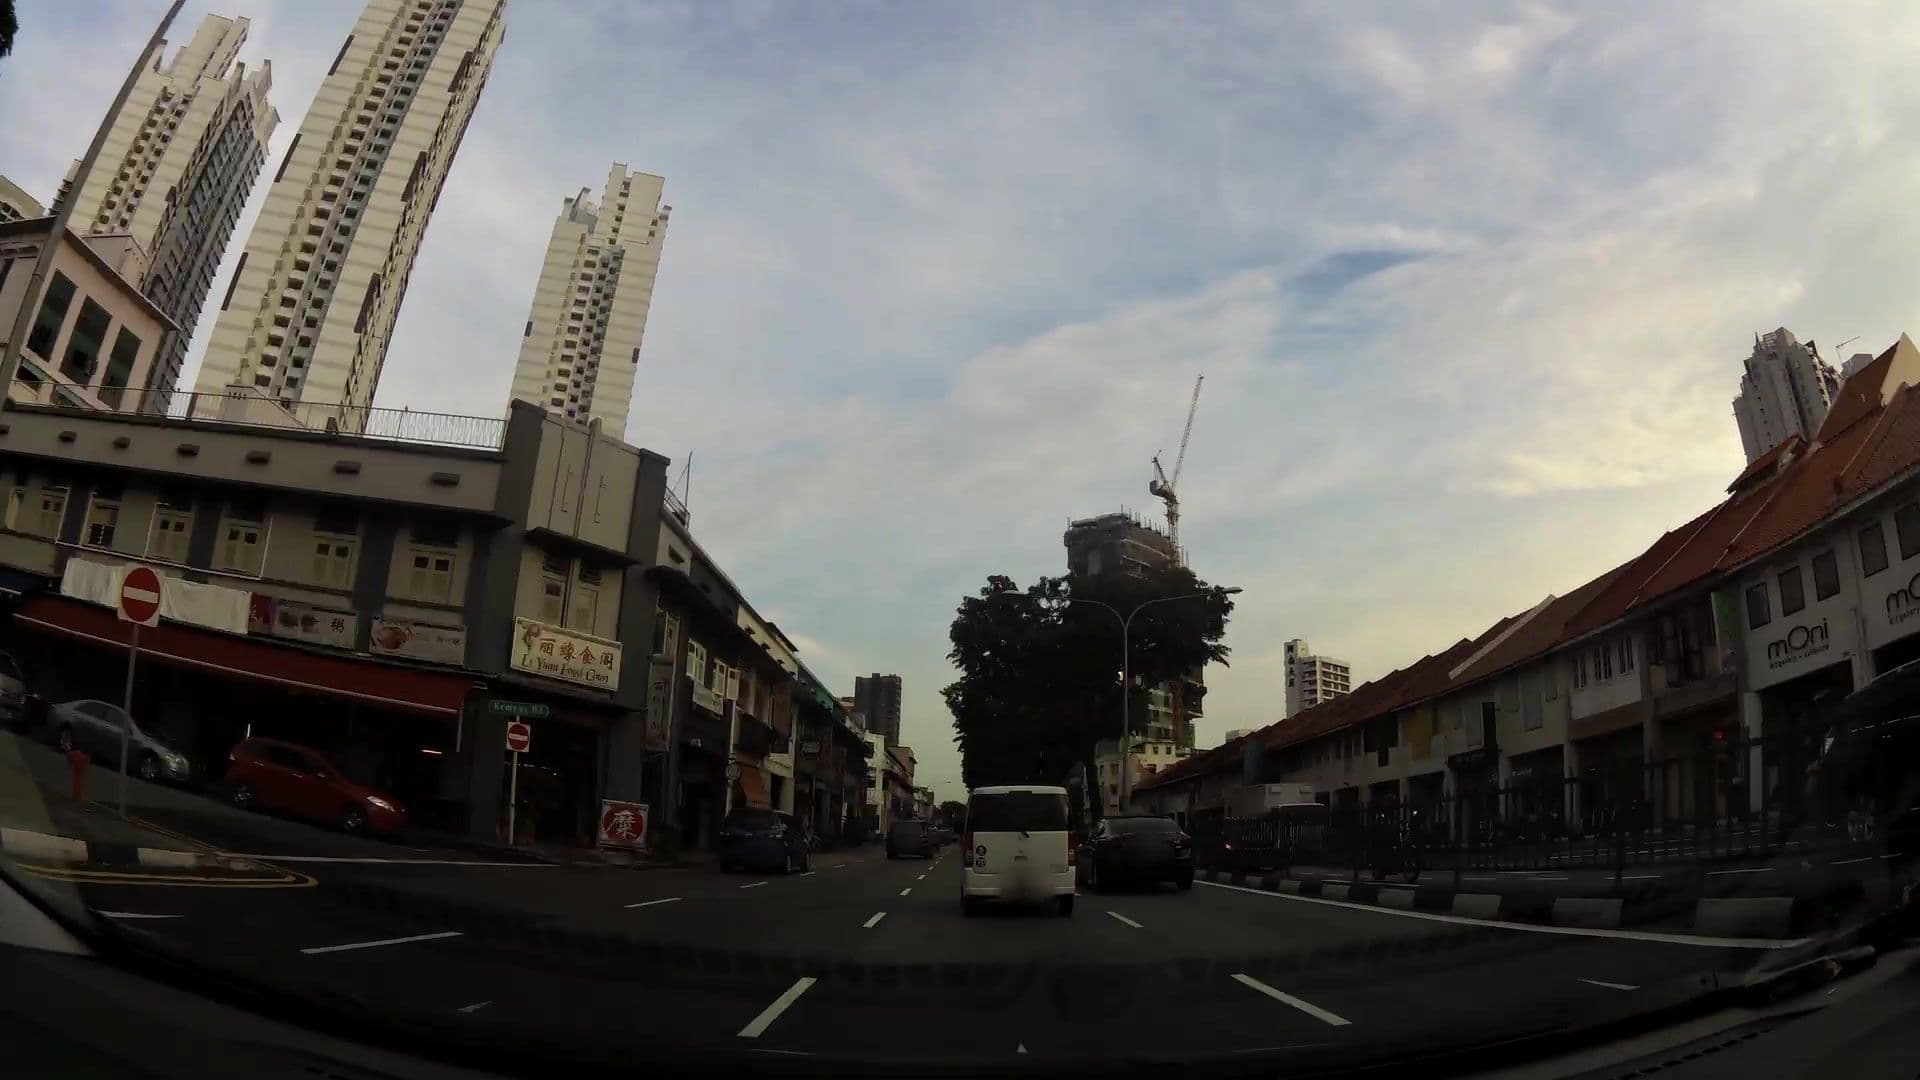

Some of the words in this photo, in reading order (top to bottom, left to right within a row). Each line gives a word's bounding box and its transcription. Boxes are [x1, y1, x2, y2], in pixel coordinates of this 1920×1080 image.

[1767, 617, 1829, 660] mOni
[537, 656, 558, 673] Yuan
[561, 662, 583, 679] Food
